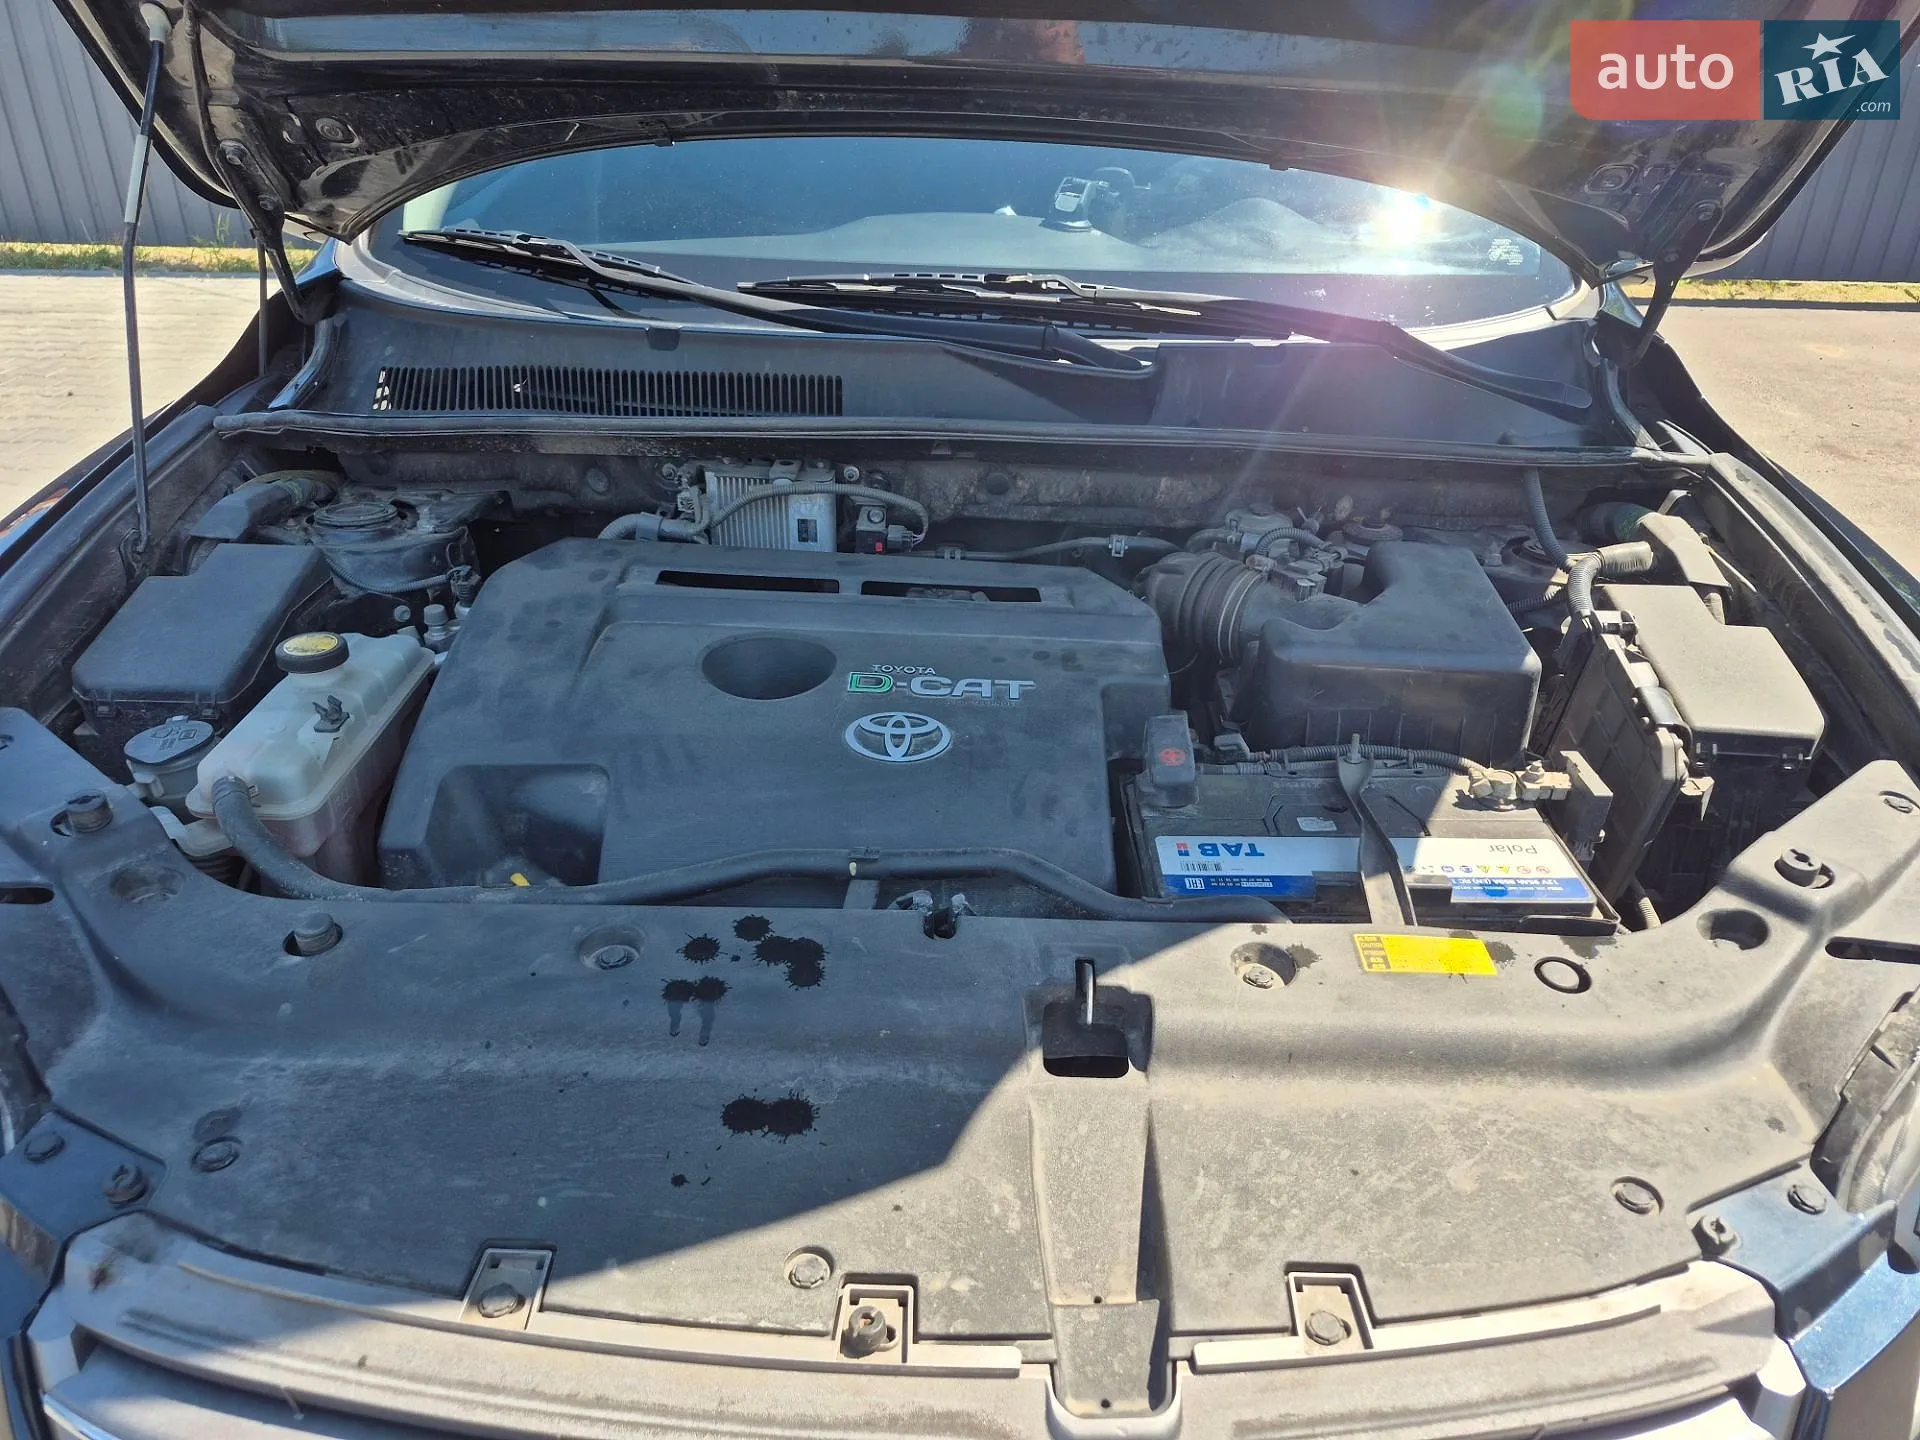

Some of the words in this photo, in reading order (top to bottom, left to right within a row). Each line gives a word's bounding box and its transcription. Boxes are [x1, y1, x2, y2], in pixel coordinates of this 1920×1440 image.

[872, 664, 936, 675] TOYOTA
[846, 671, 1036, 700] D-CAT
[1197, 842, 1265, 857] TAB
[1488, 844, 1538, 856] Polar
